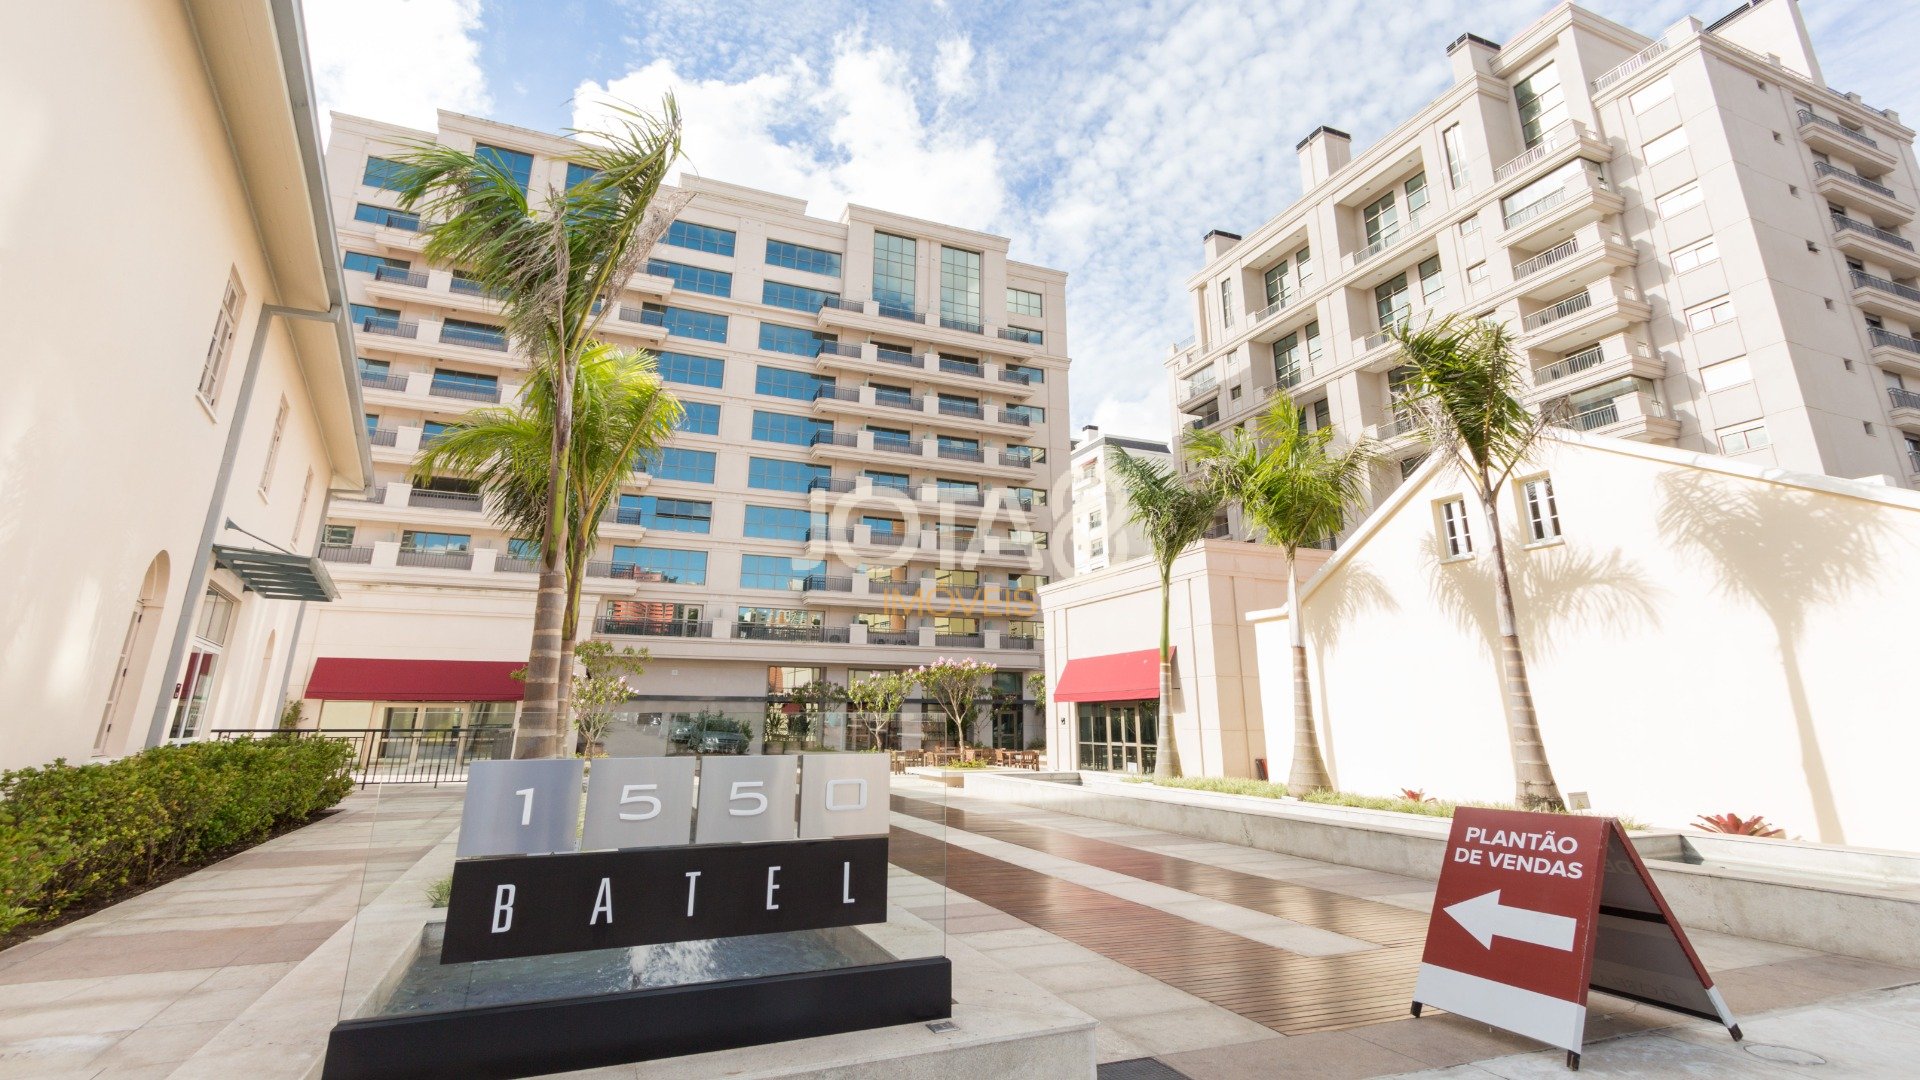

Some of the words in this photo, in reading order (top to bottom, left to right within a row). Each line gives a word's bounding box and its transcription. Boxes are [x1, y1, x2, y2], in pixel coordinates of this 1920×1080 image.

[515, 778, 868, 826] 1550
[1465, 826, 1578, 855] PLANTÃO
[1454, 847, 1483, 865] DE
[1488, 852, 1584, 880] VENDAS
[491, 861, 855, 934] BATEL
